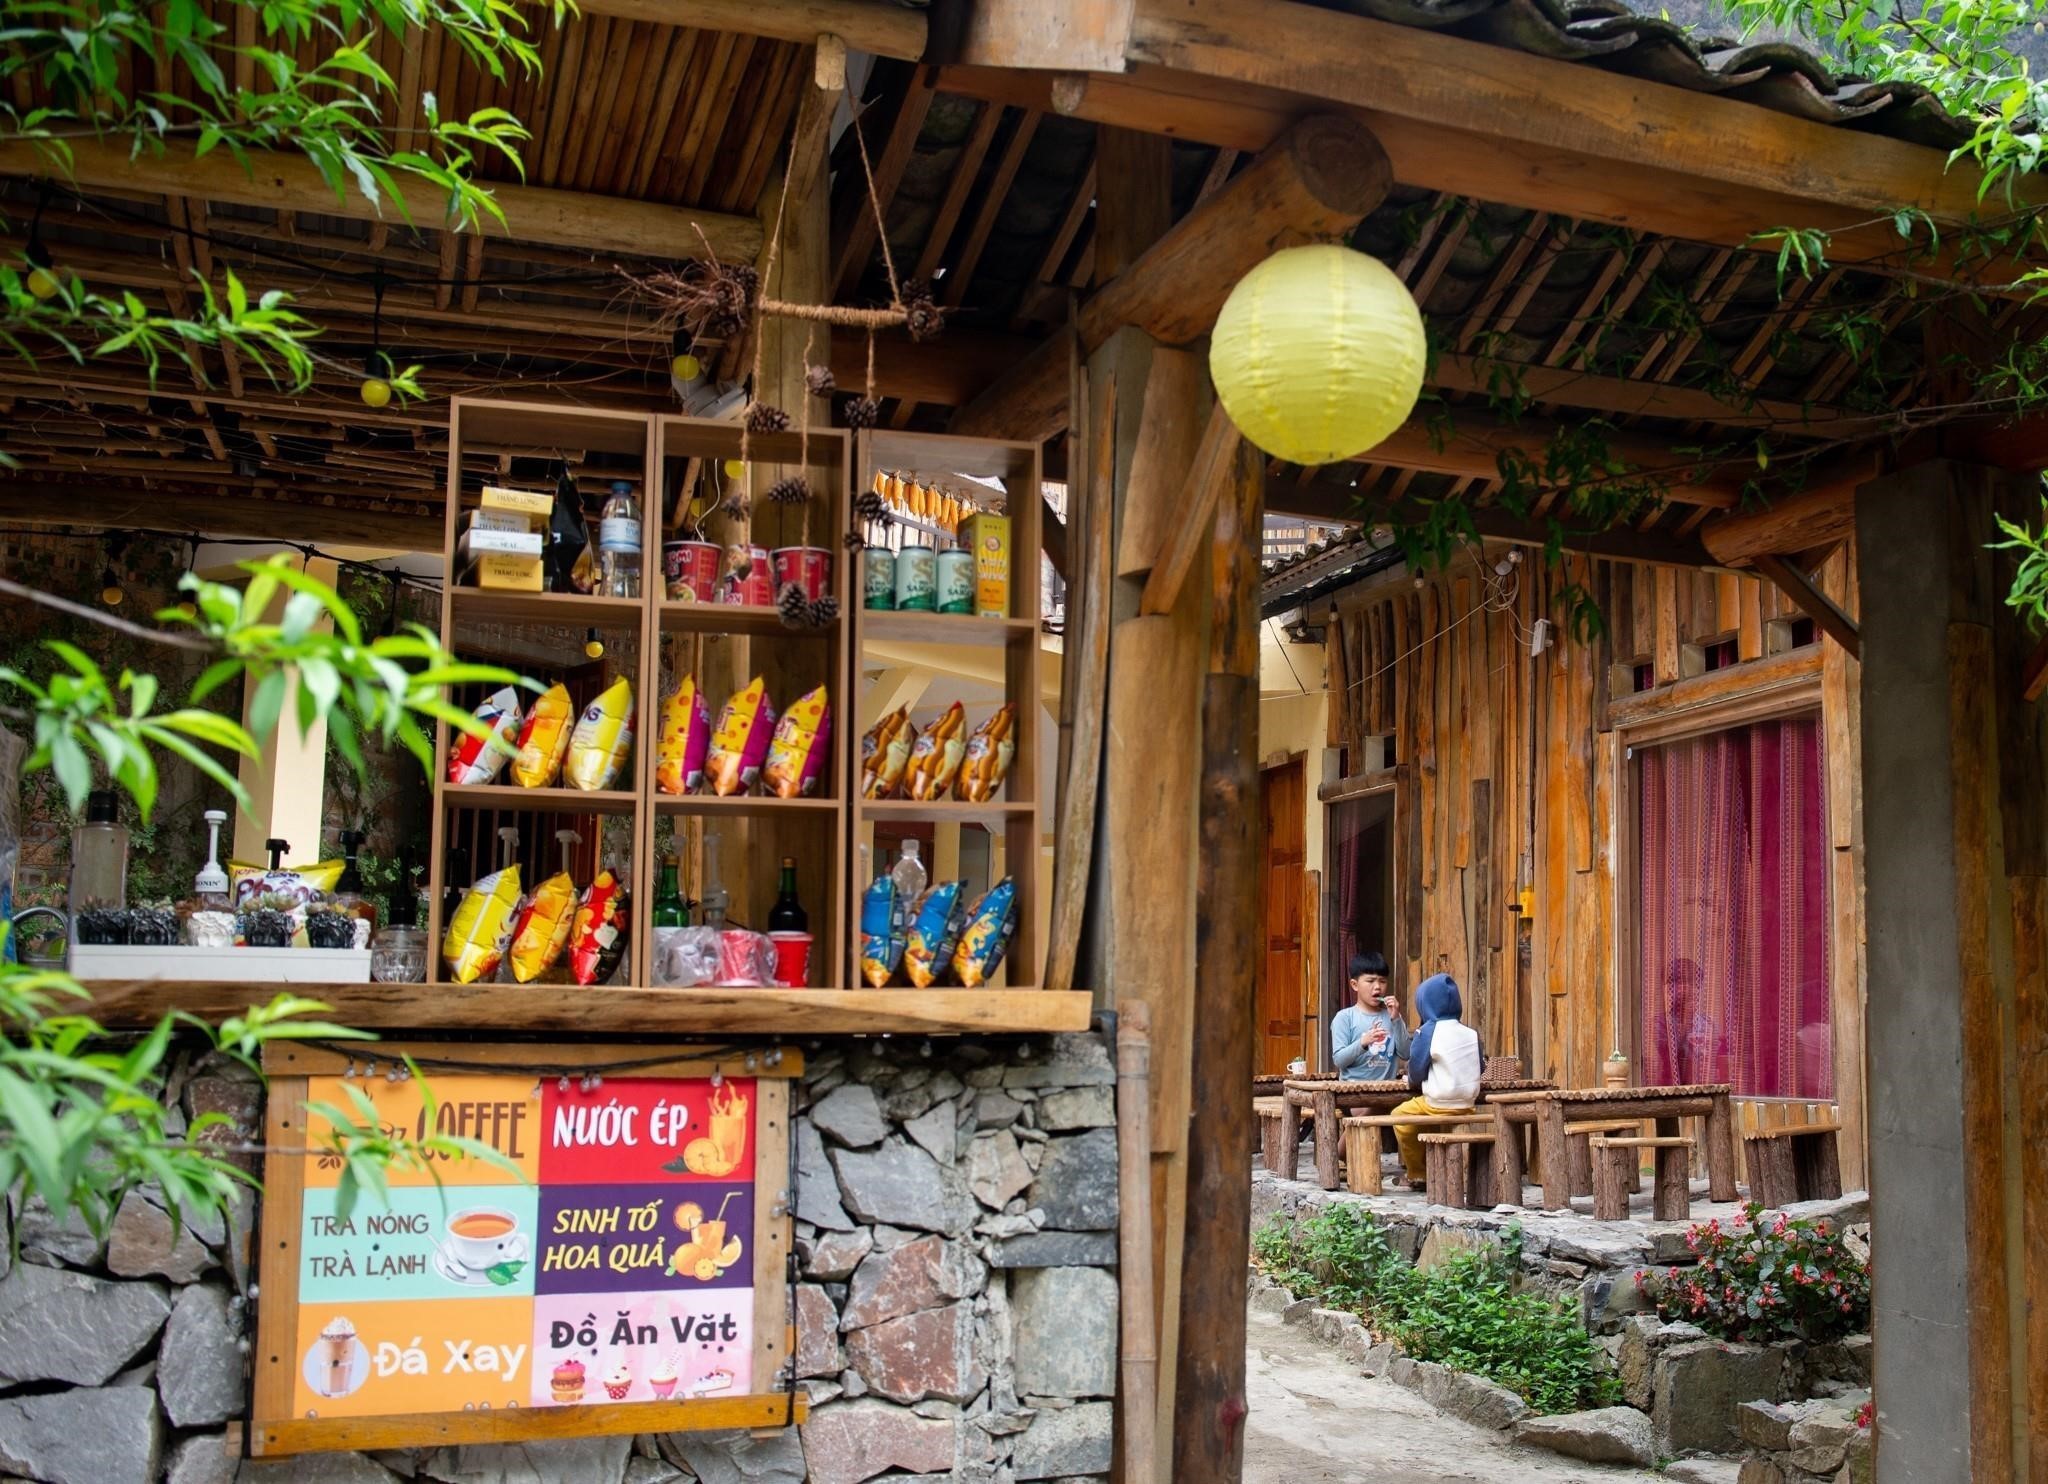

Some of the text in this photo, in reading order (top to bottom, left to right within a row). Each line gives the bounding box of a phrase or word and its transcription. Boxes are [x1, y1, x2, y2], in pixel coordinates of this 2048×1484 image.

[417, 1102, 526, 1160] COFFEE
[553, 1098, 688, 1148] NƯỚC ÉP
[367, 1208, 429, 1235] NÓNG
[553, 1199, 663, 1234] SINH TỐ
[309, 1249, 426, 1281] TRÀ LẠNH
[543, 1236, 665, 1273] HOA QUẢ
[550, 1310, 737, 1350] Đồ Ăn Vặt
[373, 1336, 526, 1382] Đá Xay
